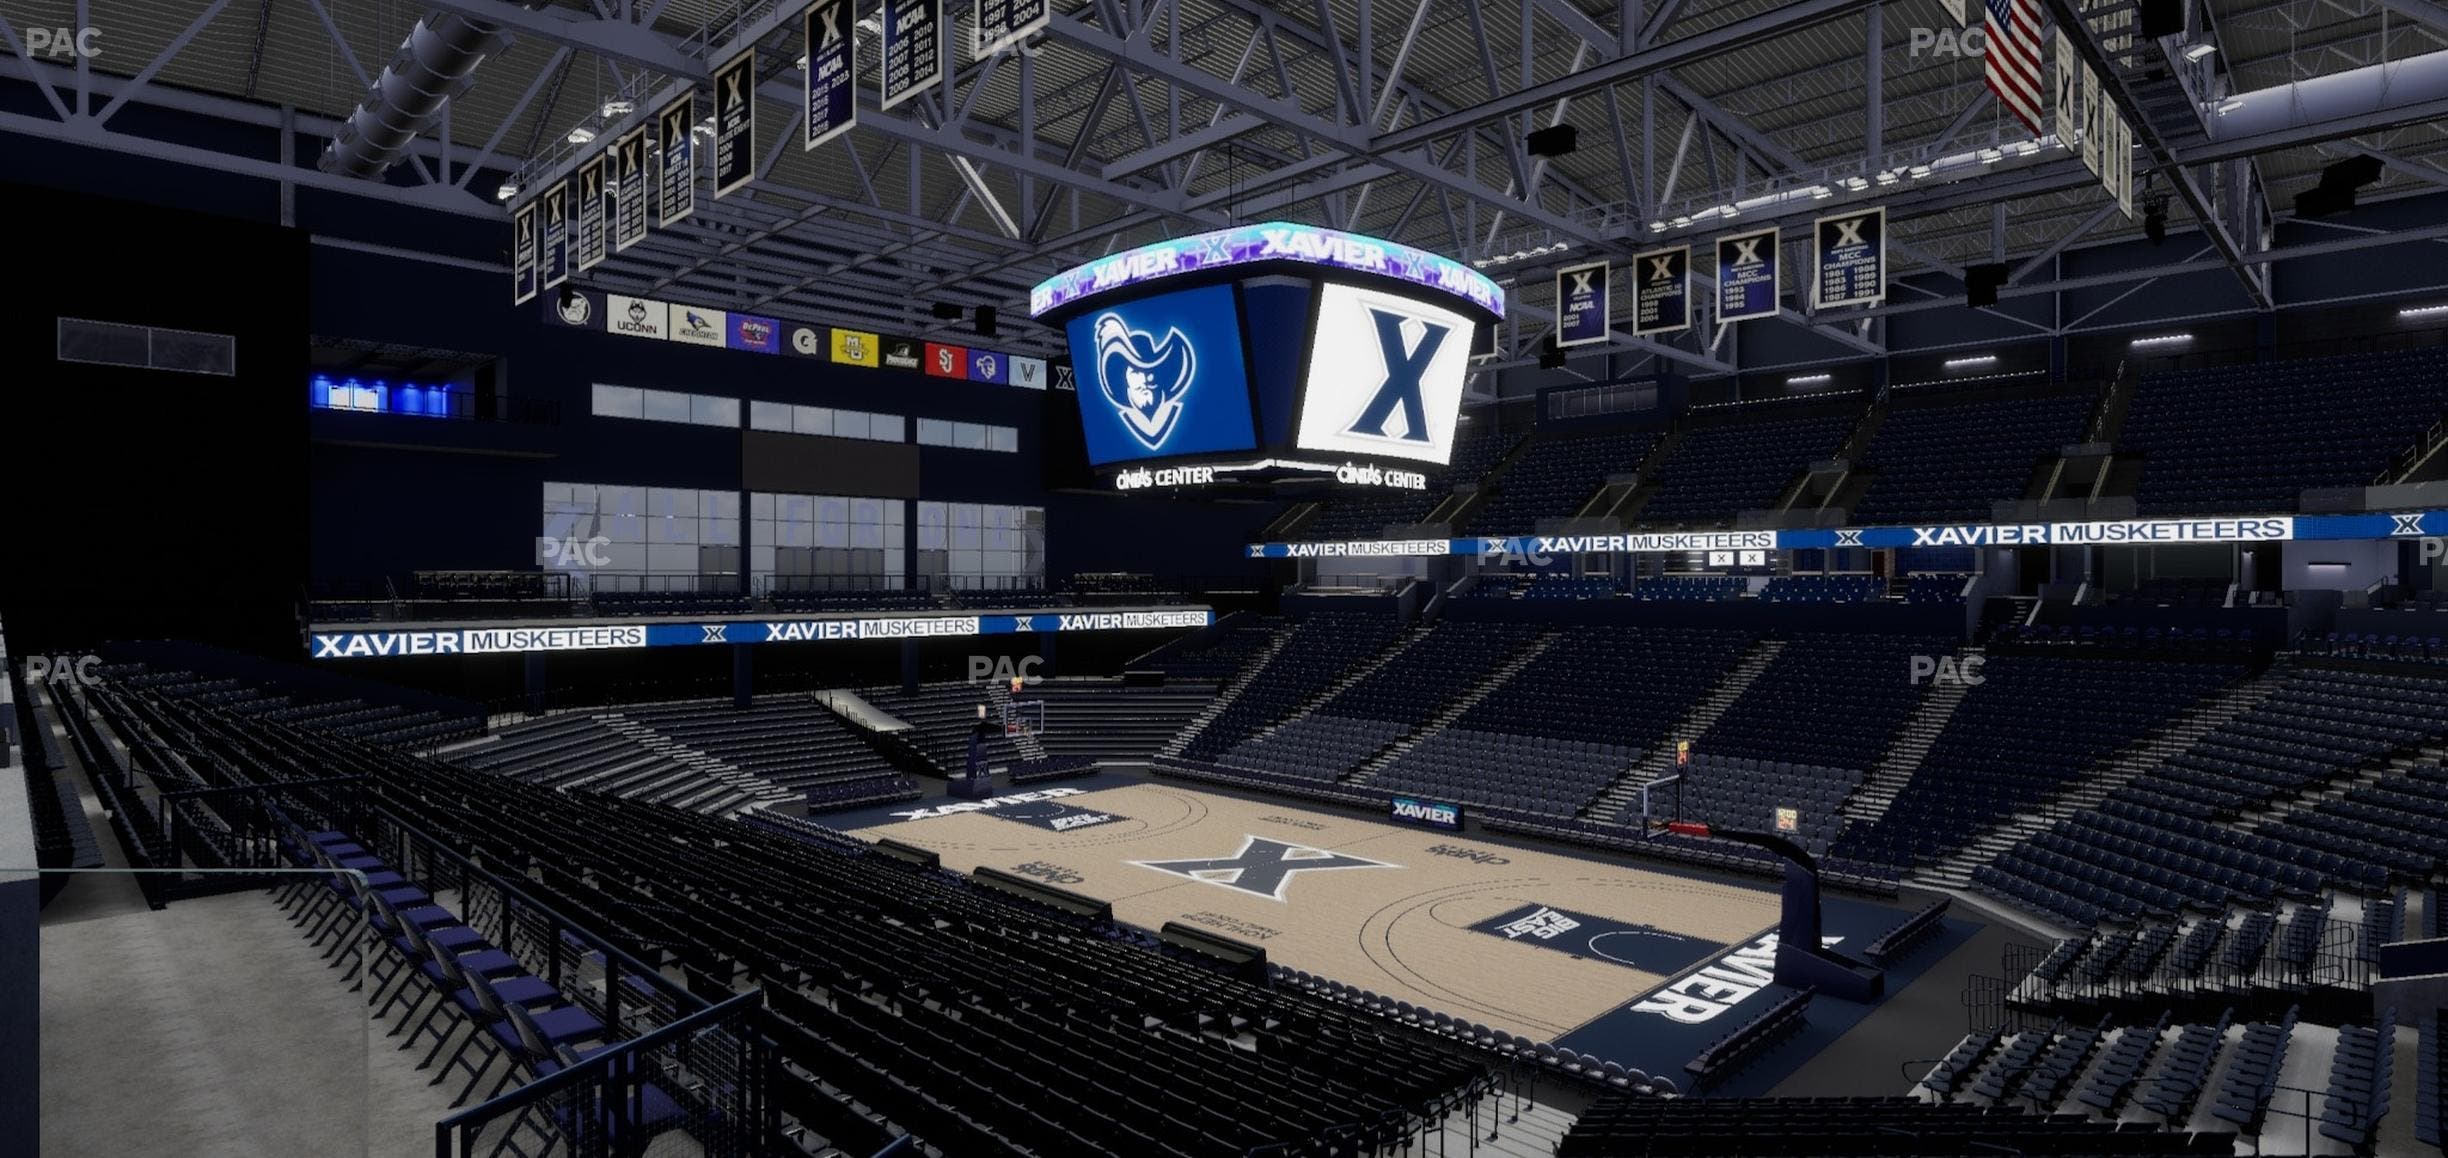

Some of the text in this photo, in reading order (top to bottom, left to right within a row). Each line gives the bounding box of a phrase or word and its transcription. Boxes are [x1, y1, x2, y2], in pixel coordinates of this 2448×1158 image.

[821, 2, 843, 50] X
[896, 4, 927, 36] NCAA
[984, 2, 1039, 27] 1997 2004
[889, 22, 933, 56] 2006 2010
[984, 21, 1007, 42] 1998
[817, 54, 844, 82] NCAA
[889, 37, 933, 70] 2007 2011
[889, 51, 934, 83] 2008 2012
[726, 68, 744, 112] X
[889, 63, 934, 97] 2009 2014
[669, 109, 684, 149] X
[624, 142, 637, 176] X
[586, 169, 597, 200] X
[550, 195, 561, 225] X
[1832, 217, 1867, 249] X
[1732, 237, 1763, 266] X
[1824, 256, 1876, 270] CHAMPIONS
[1838, 251, 1861, 261] MCC
[1093, 248, 1179, 288] XAVIER
[1202, 233, 1232, 266] X
[1259, 228, 1387, 270] XAVIER
[1403, 251, 1425, 281] X
[1438, 262, 1492, 305] XAVIER
[1650, 255, 1675, 280] X
[1737, 270, 1758, 279] MCC
[1570, 271, 1595, 296] X
[1724, 275, 1772, 288] CHAMPIONS
[1725, 287, 1745, 295] 1993
[1854, 281, 1876, 289] 1990
[1854, 289, 1875, 297] 1991
[1569, 300, 1595, 312] NCAA
[1725, 294, 1745, 302] 1994
[617, 320, 657, 335] UCONN
[1021, 363, 1036, 382] V
[1345, 304, 1453, 444] X
[1155, 466, 1214, 486] CENTER
[1384, 471, 1426, 490] CENTER
[1250, 545, 1265, 557] X
[1287, 543, 1347, 557] XAVIER
[1351, 540, 1447, 554] MUSKETEERS
[1538, 536, 1625, 552] XAVIER
[1632, 533, 1771, 550] MUSKETEERS
[1835, 530, 1864, 546] X
[1912, 525, 2047, 547] XAVIER
[2059, 519, 2285, 542] MUSKETEERS
[2390, 513, 2425, 536] X
[315, 612, 1206, 658] XAVIER MUSKETEERS X XAVIER MUSKETEERS X XAVIER MUSKETEERS
[889, 787, 1088, 821] XAVIER
[1392, 801, 1456, 825] XAVIER
[1120, 834, 1406, 903] X
[1630, 929, 1845, 1024] AVIER
